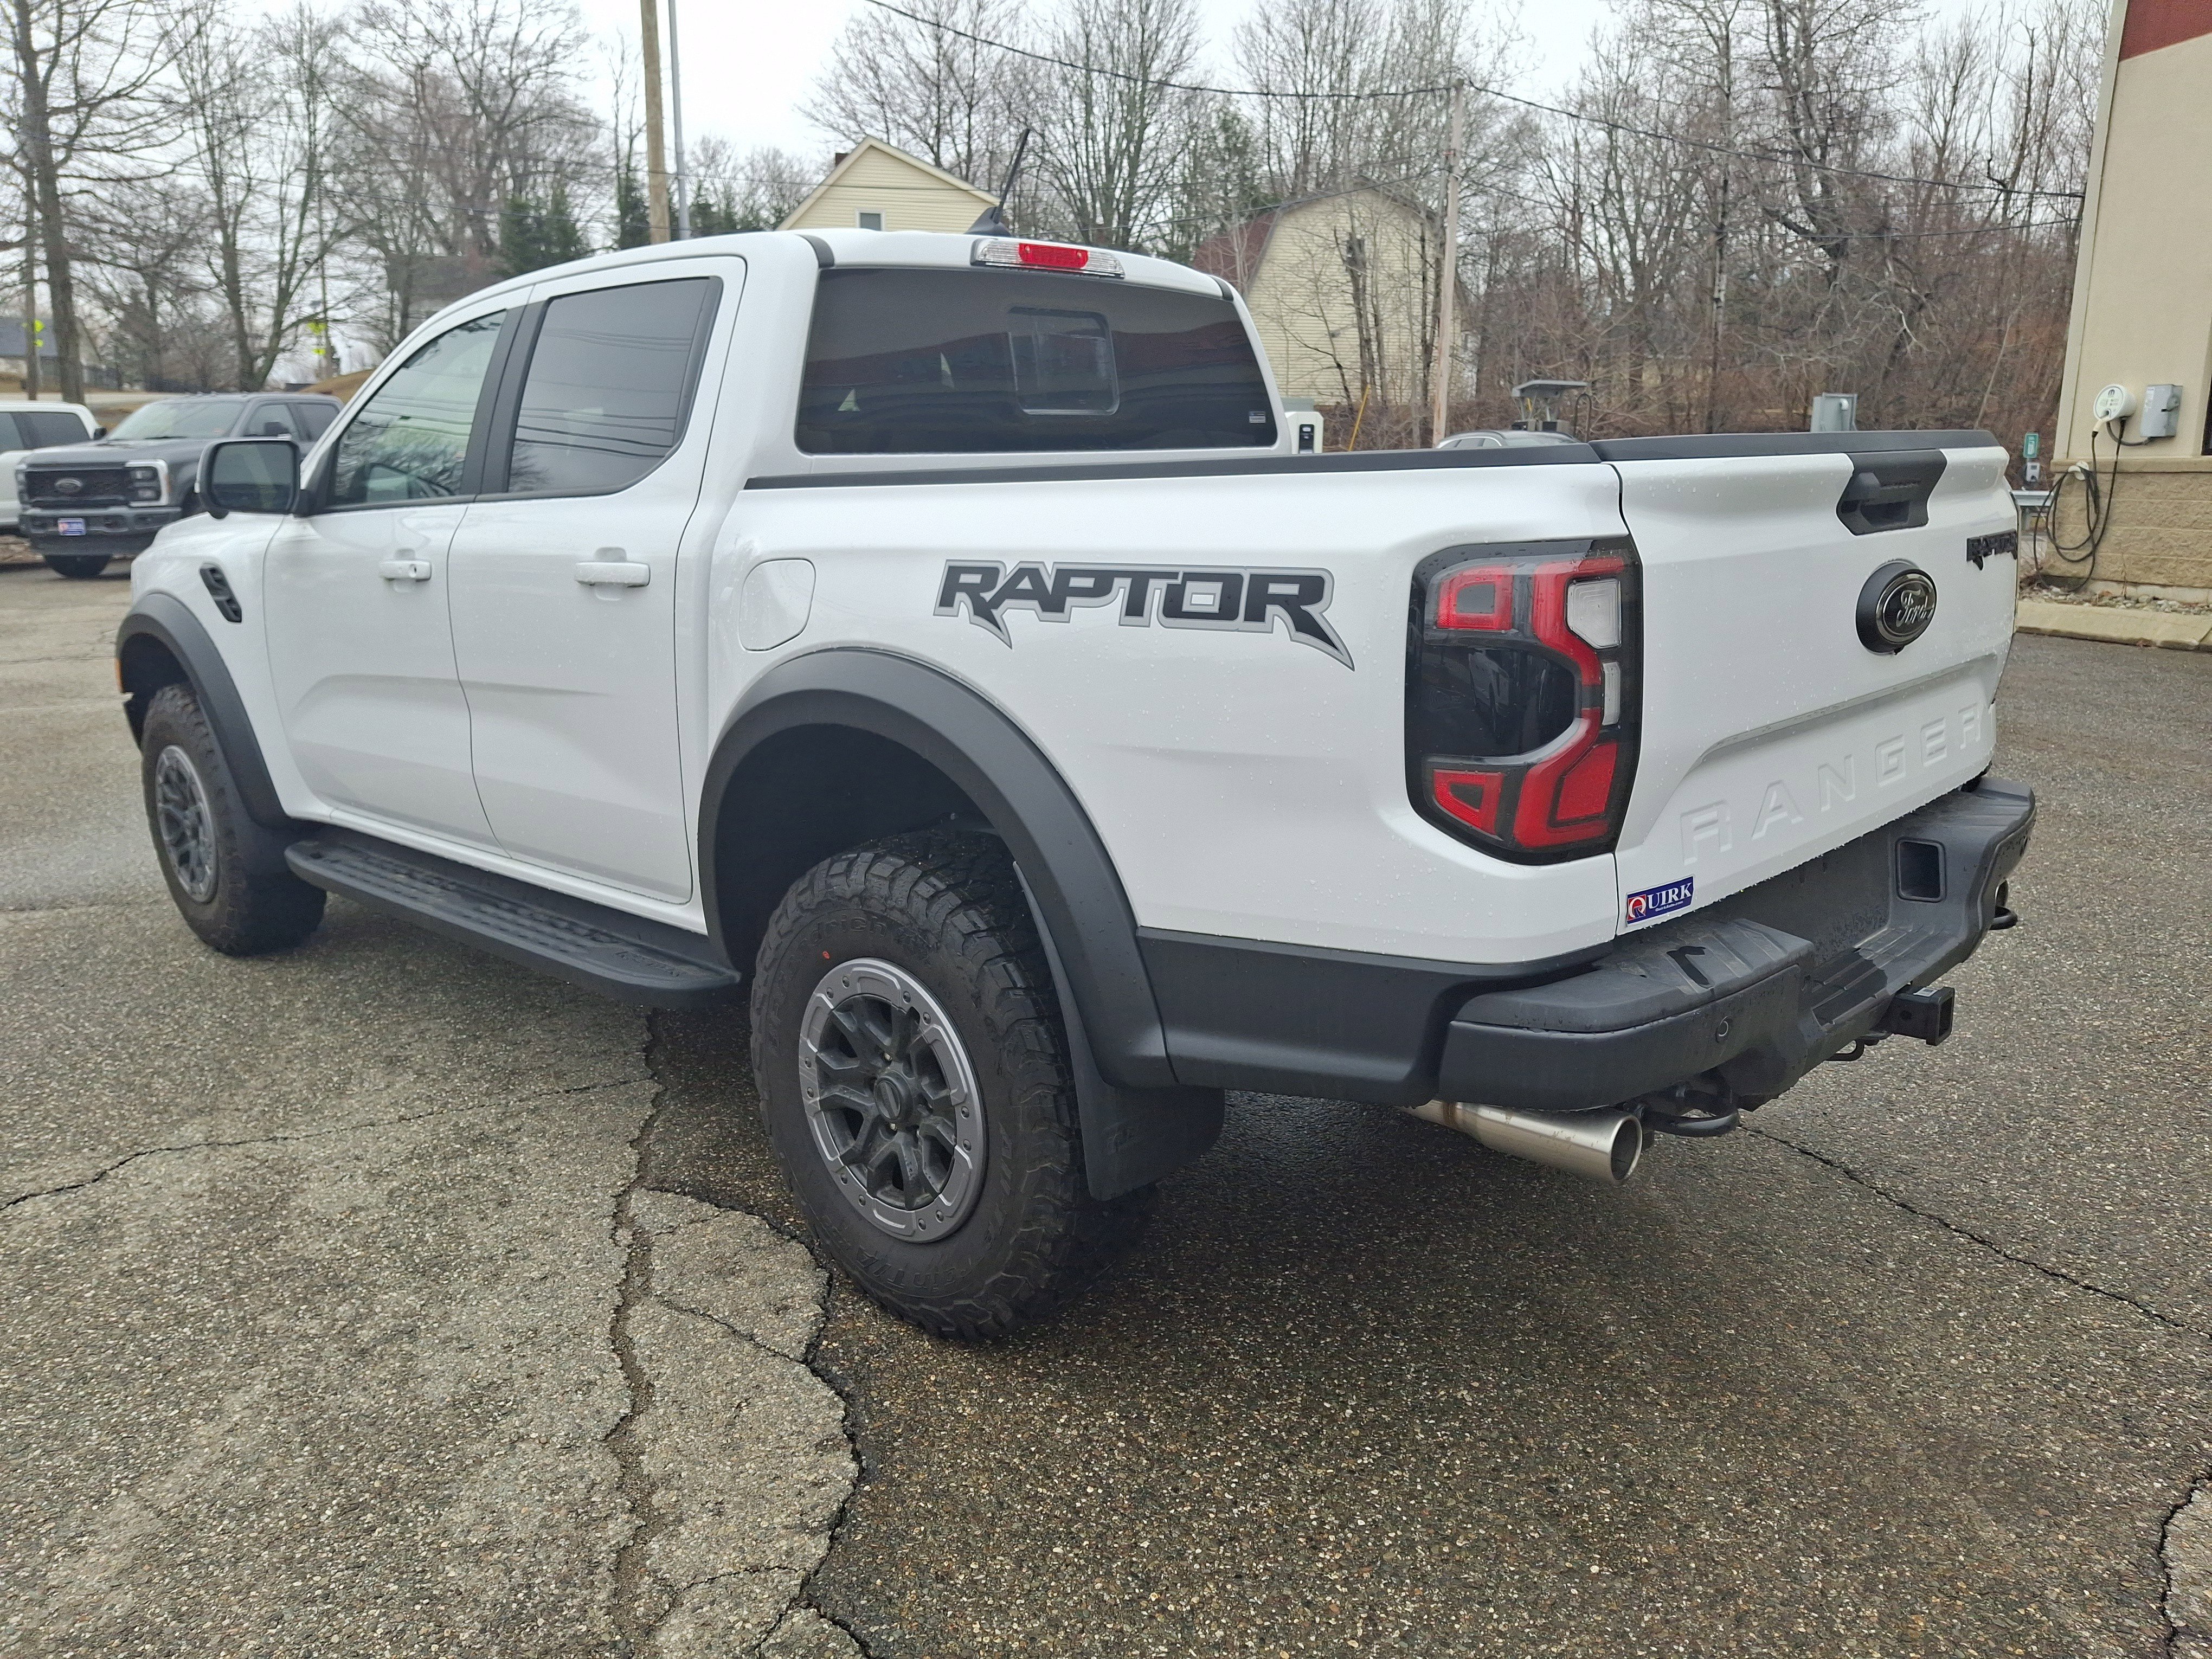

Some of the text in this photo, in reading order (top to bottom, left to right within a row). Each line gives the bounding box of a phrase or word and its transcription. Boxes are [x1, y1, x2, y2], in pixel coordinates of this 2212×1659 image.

[933, 558, 1355, 672] RAPTOR
[1896, 588, 1934, 627] Ford
[1680, 703, 1982, 866] RANGER
[1628, 882, 1692, 919] QUIRK
